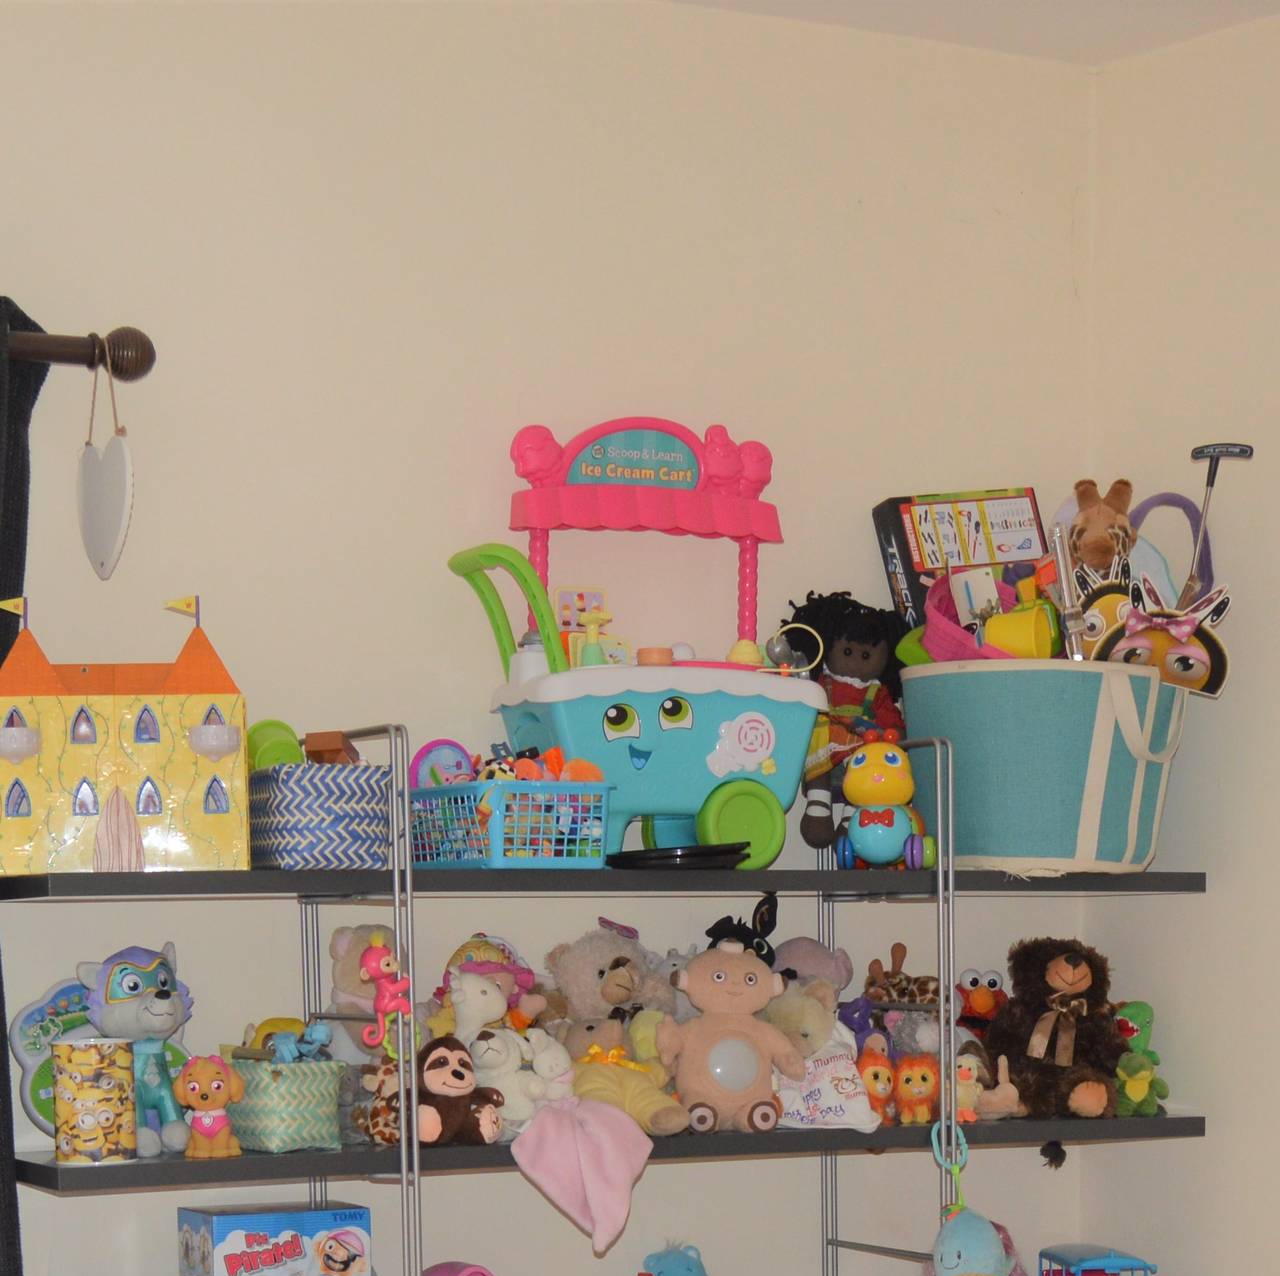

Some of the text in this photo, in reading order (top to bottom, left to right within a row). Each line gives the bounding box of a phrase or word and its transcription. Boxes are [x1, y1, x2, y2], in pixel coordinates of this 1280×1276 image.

[607, 447, 683, 462] Scoop & Learn
[581, 462, 693, 482] Ice Cream Cart
[331, 1211, 366, 1223] TOMY
